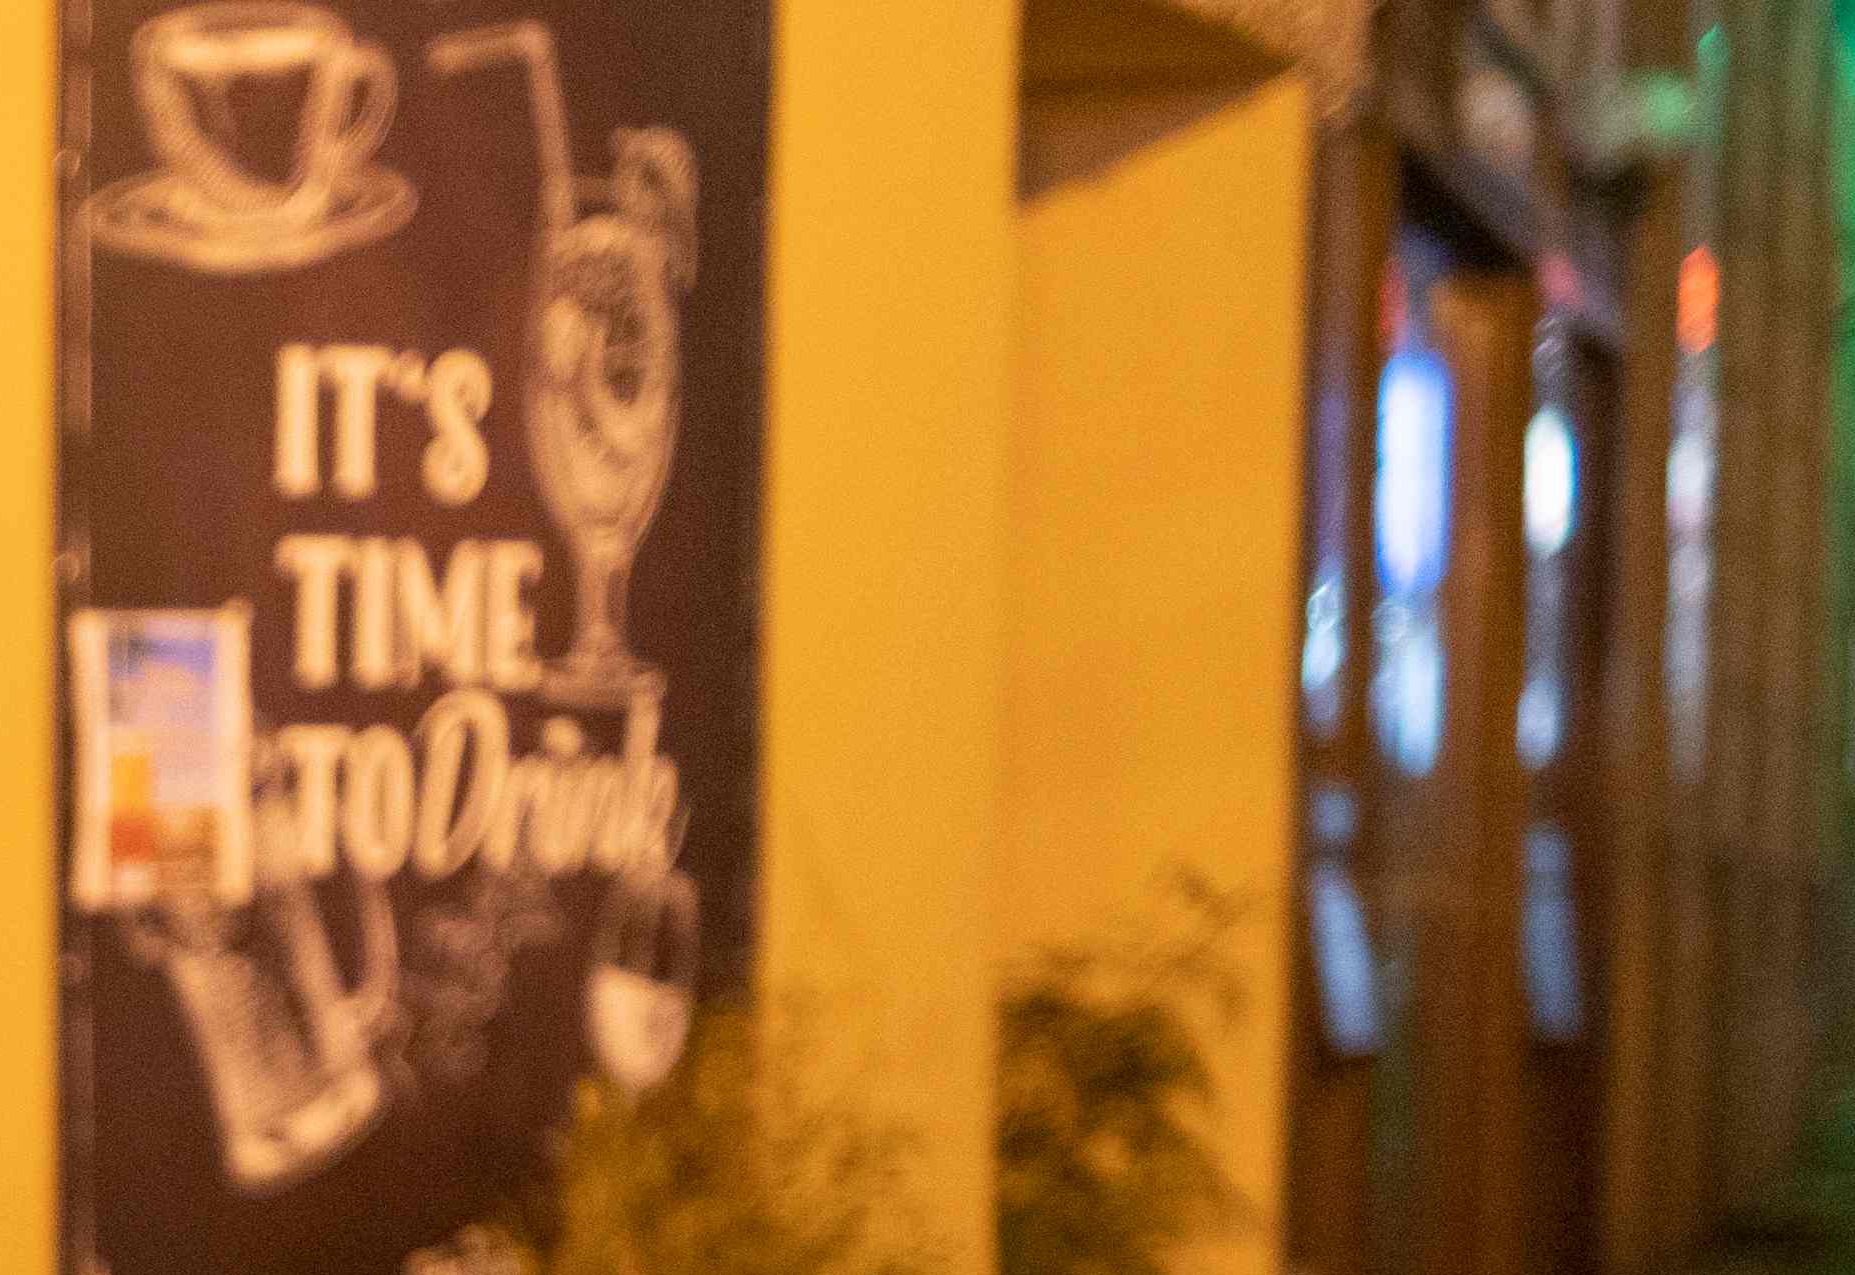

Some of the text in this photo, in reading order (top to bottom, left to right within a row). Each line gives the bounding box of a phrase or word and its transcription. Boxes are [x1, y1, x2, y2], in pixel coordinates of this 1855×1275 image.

[274, 343, 492, 504] IT'S
[273, 534, 545, 689] TIME
[277, 672, 687, 882] TO Drink
